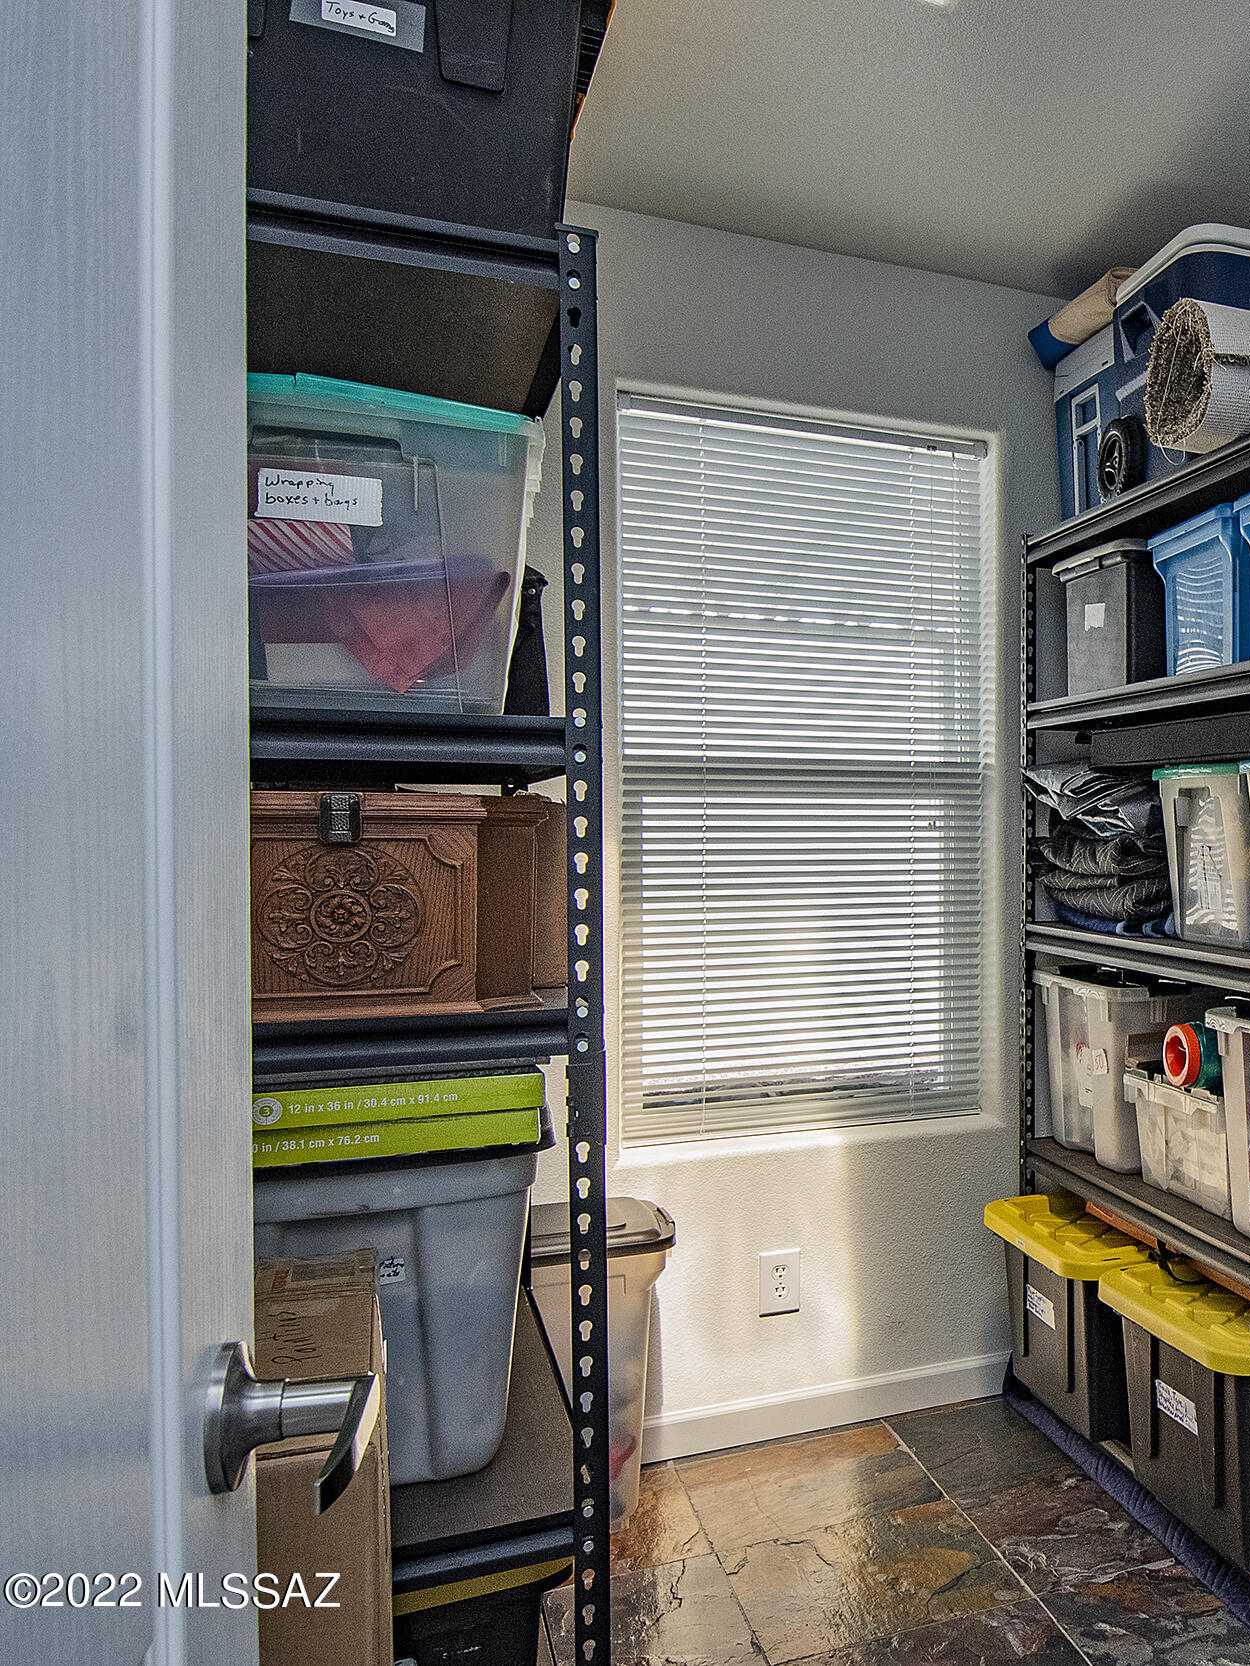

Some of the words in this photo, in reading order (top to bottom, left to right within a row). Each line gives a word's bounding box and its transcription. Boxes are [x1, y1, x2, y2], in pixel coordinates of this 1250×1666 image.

[326, 1, 355, 20] Toys
[265, 474, 335, 496] Wrapping
[265, 492, 309, 505] boxes
[324, 492, 358, 510] bags
[262, 1107, 271, 1116] 3
[288, 1104, 301, 1114] 12
[305, 1104, 315, 1113] in
[327, 1101, 341, 1111] 36
[344, 1100, 354, 1110] in
[364, 1098, 388, 1108] 30.4
[390, 1098, 406, 1107] cm
[409, 1097, 415, 1105] x
[417, 1094, 440, 1104] 91.4
[442, 1094, 458, 1102] cm
[262, 1142, 272, 1152] in
[282, 1140, 305, 1150] 38.1
[308, 1138, 325, 1148] cm
[328, 1138, 334, 1146] x
[337, 1134, 361, 1146] 76.2
[364, 1134, 380, 1144] cm
